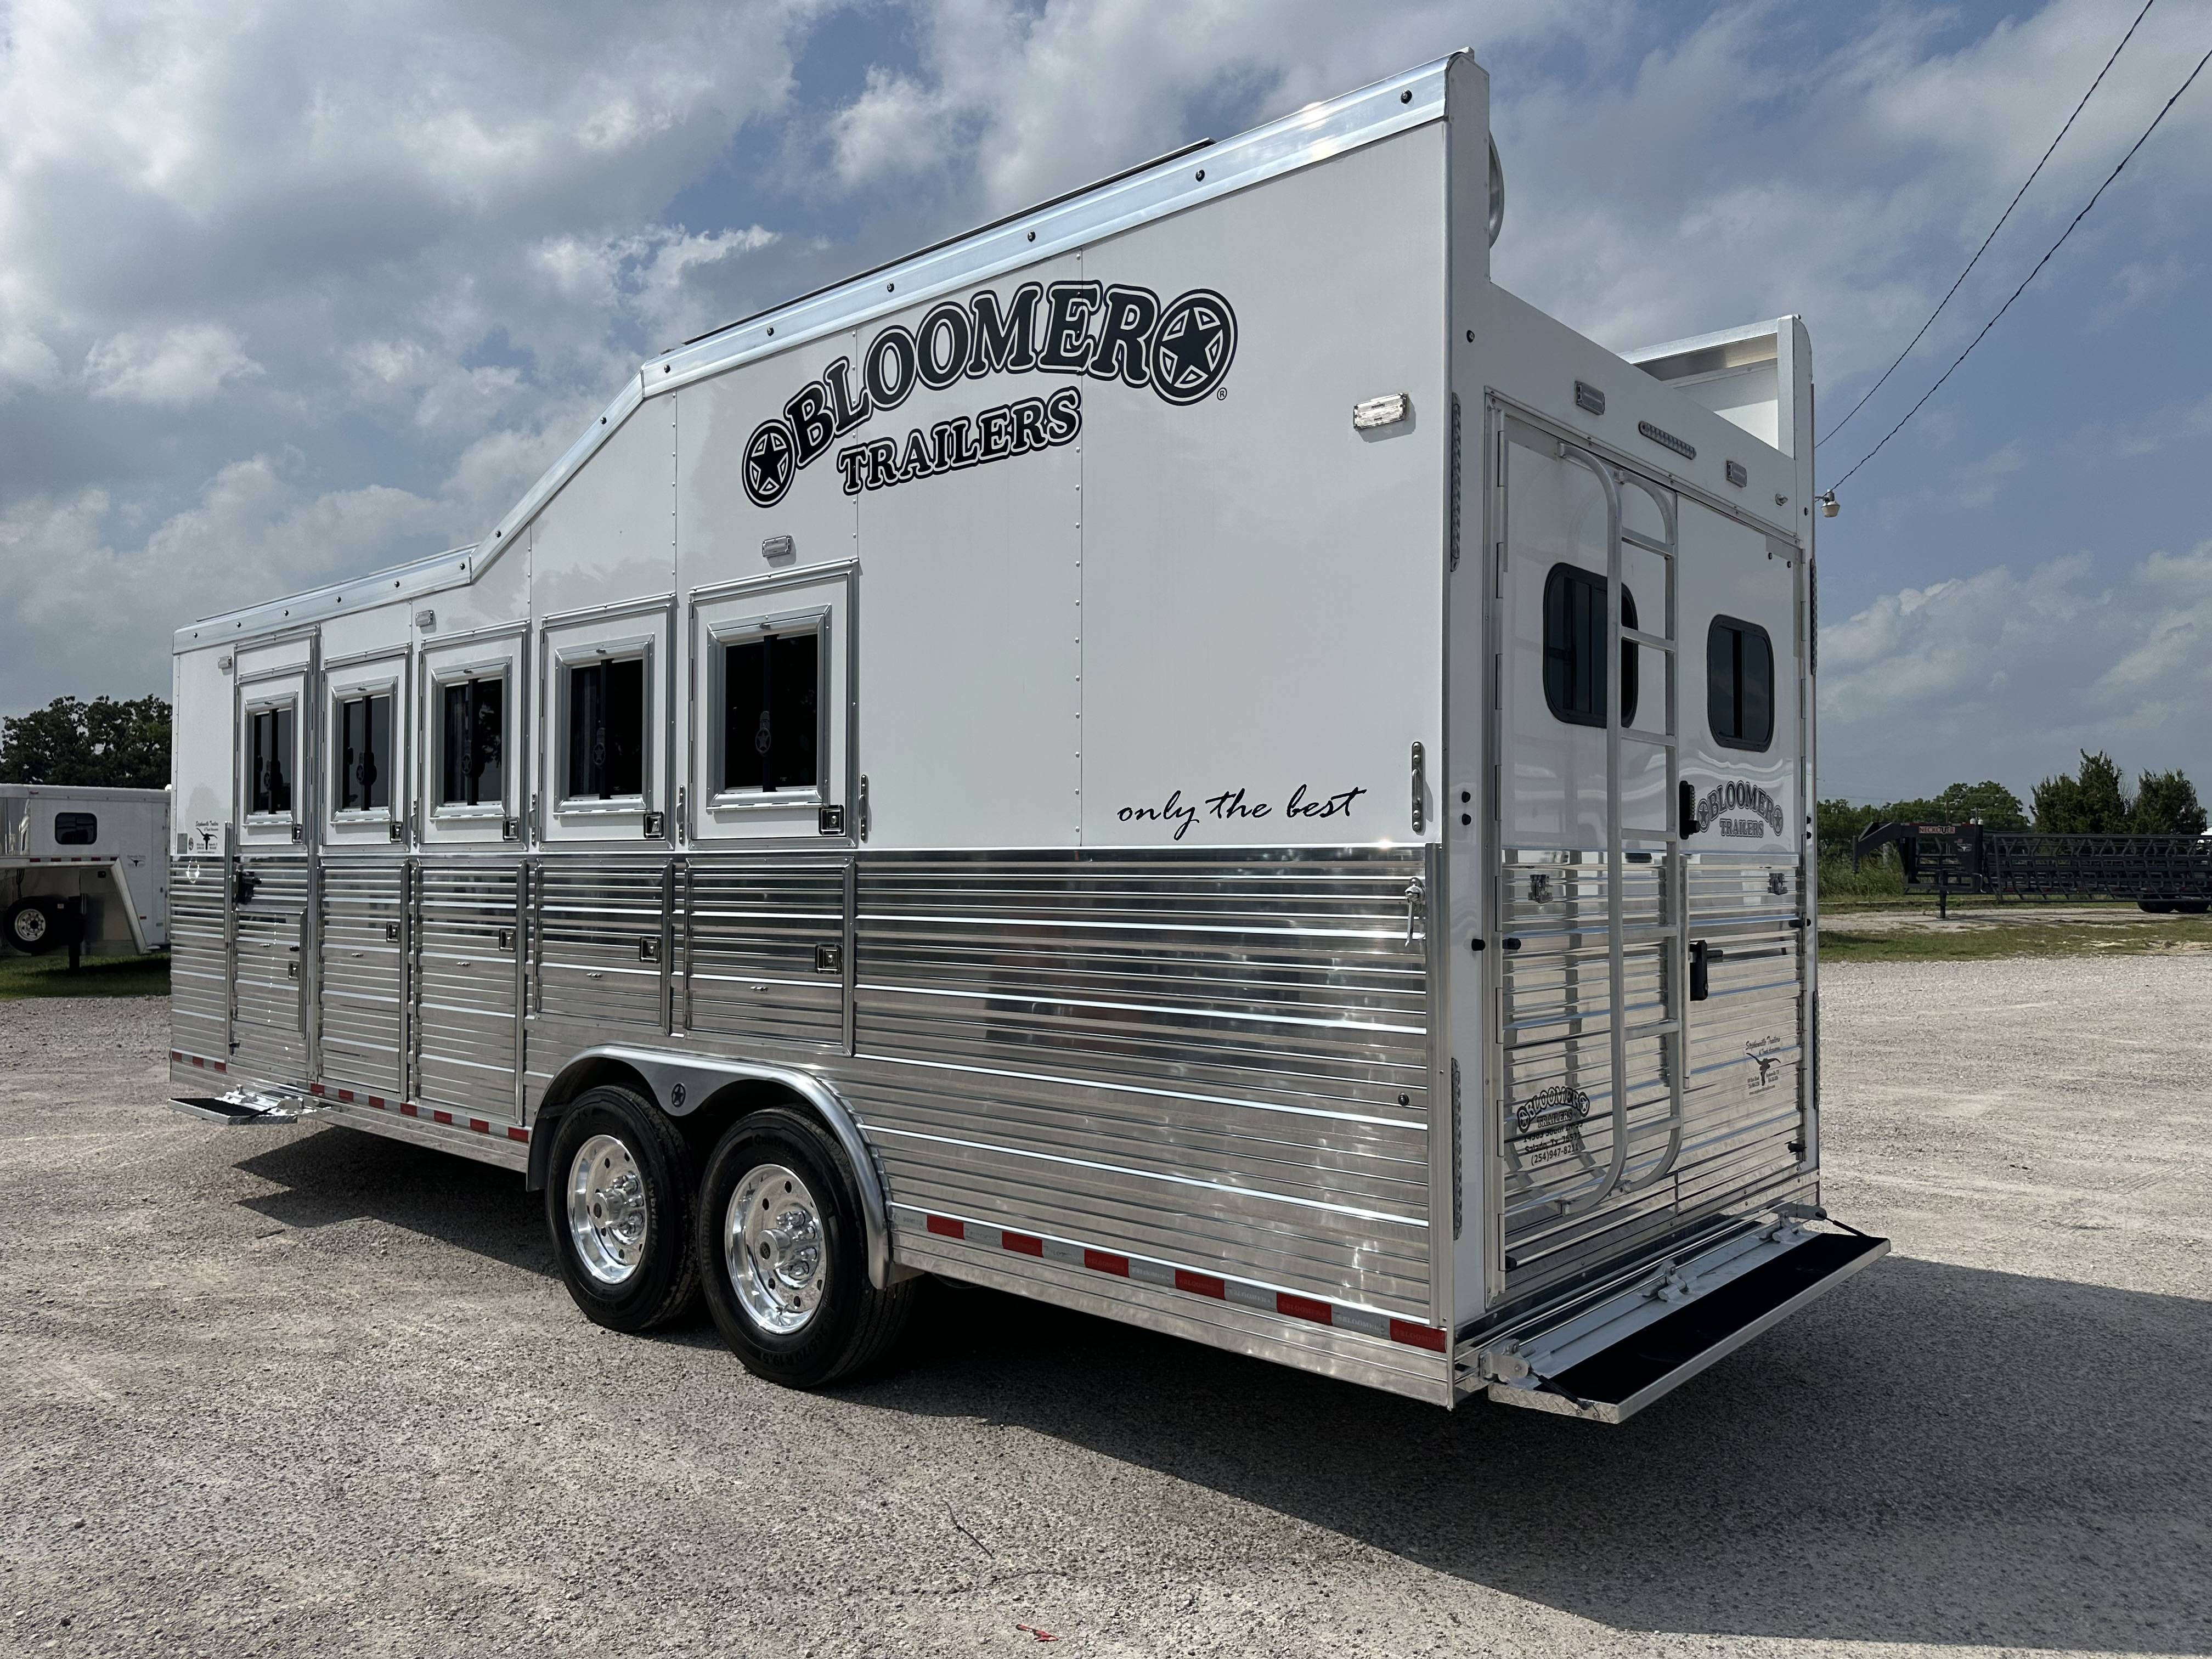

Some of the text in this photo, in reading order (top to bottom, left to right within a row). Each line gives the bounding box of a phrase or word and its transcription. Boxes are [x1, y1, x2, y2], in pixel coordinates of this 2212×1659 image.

[783, 280, 1159, 467] BLOOMER
[837, 386, 1081, 494] TRAILERS
[1117, 784, 1368, 840] only the best
[1707, 780, 1774, 827] BLOOMER
[1719, 818, 1764, 838] TRAILERS
[1525, 1086, 1580, 1121] BLOOMER
[1537, 1109, 1573, 1128] TRAILERS
[1531, 1143, 1579, 1166] (254)947-8211
